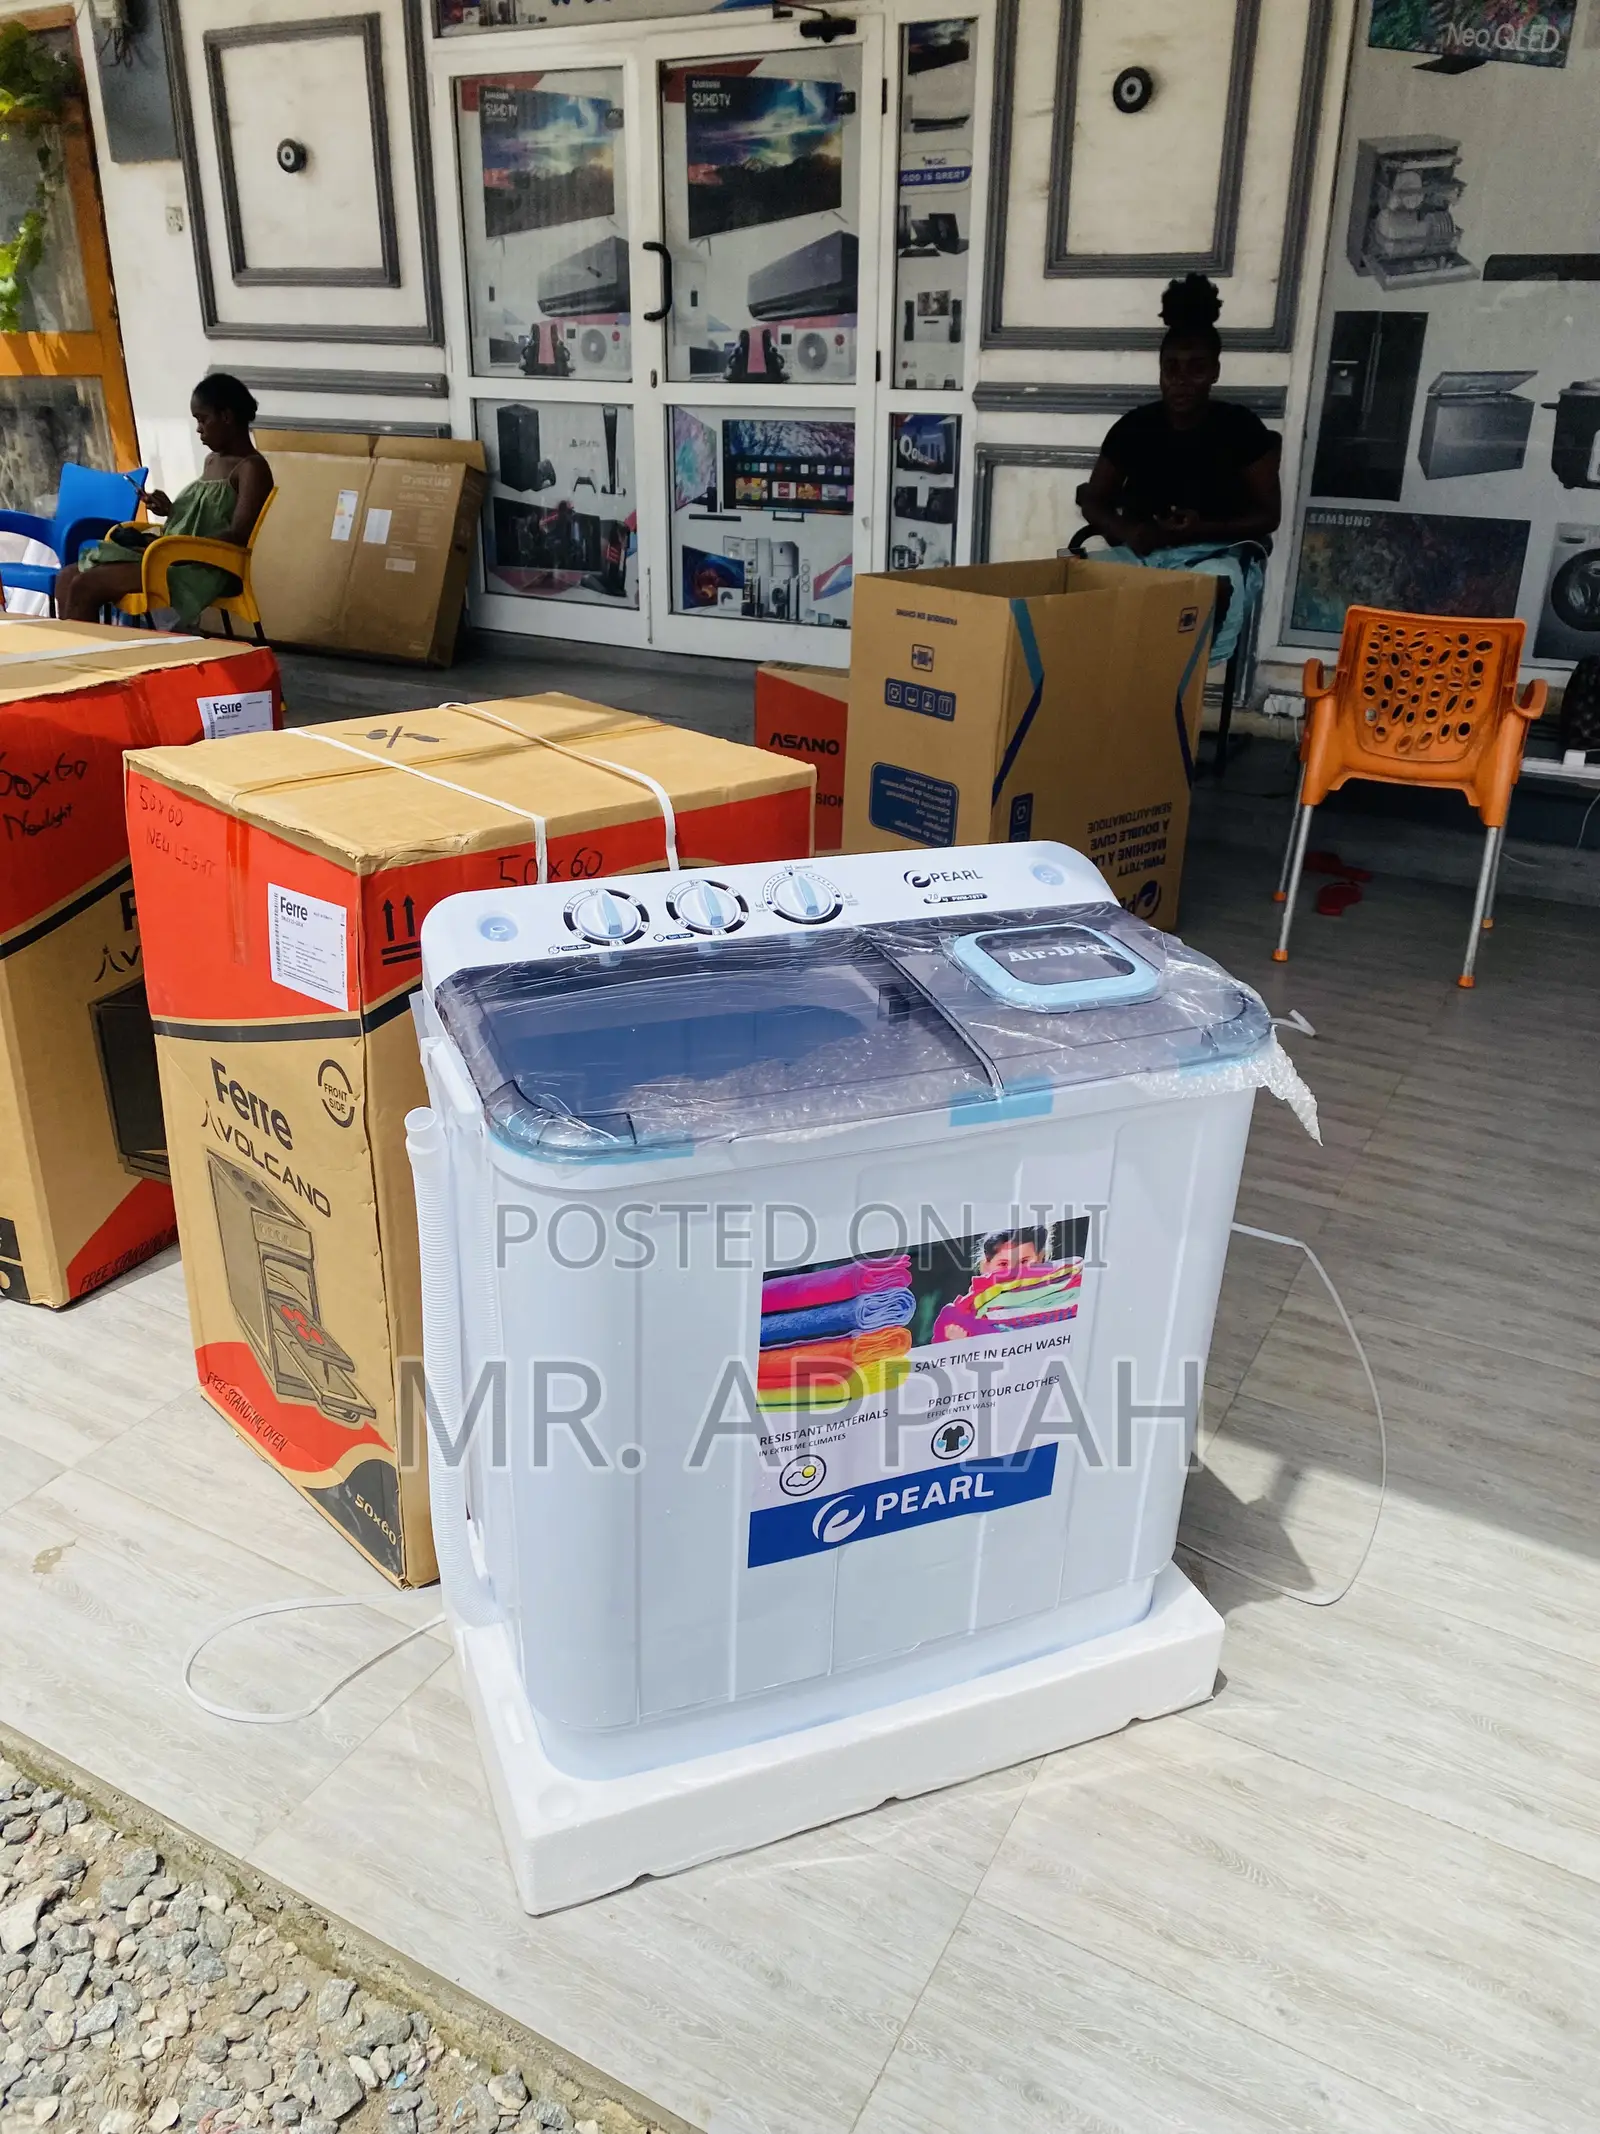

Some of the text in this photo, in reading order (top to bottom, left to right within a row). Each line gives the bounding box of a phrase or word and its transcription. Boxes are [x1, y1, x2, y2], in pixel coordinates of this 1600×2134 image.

[1308, 513, 1371, 527] SAMSUNG
[213, 702, 242, 714] Ferre
[769, 732, 840, 755] ASANO
[1090, 833, 1117, 851] CUVE
[1118, 837, 1167, 861] MACHINE
[930, 869, 983, 883] PEARL
[280, 896, 308, 921] Ferre
[210, 1057, 293, 1150] Ferre
[324, 1083, 347, 1102] FRONT
[329, 1100, 346, 1114] SIDE
[218, 1116, 331, 1218] VOLCANO
[914, 1334, 1071, 1373] SAVE TIME IN EACH WASH
[928, 1375, 1060, 1408] PROTECT YOUR CLOTHES
[205, 1372, 289, 1453] FREE STANDING OVEN
[972, 1401, 996, 1411] WASH
[760, 1408, 889, 1446] RESISTANT MATERIALS
[769, 1442, 806, 1455] EXTREME
[808, 1432, 846, 1447] CLIMATES
[875, 1473, 994, 1521] PEARL
[355, 1494, 397, 1545] 50x60
